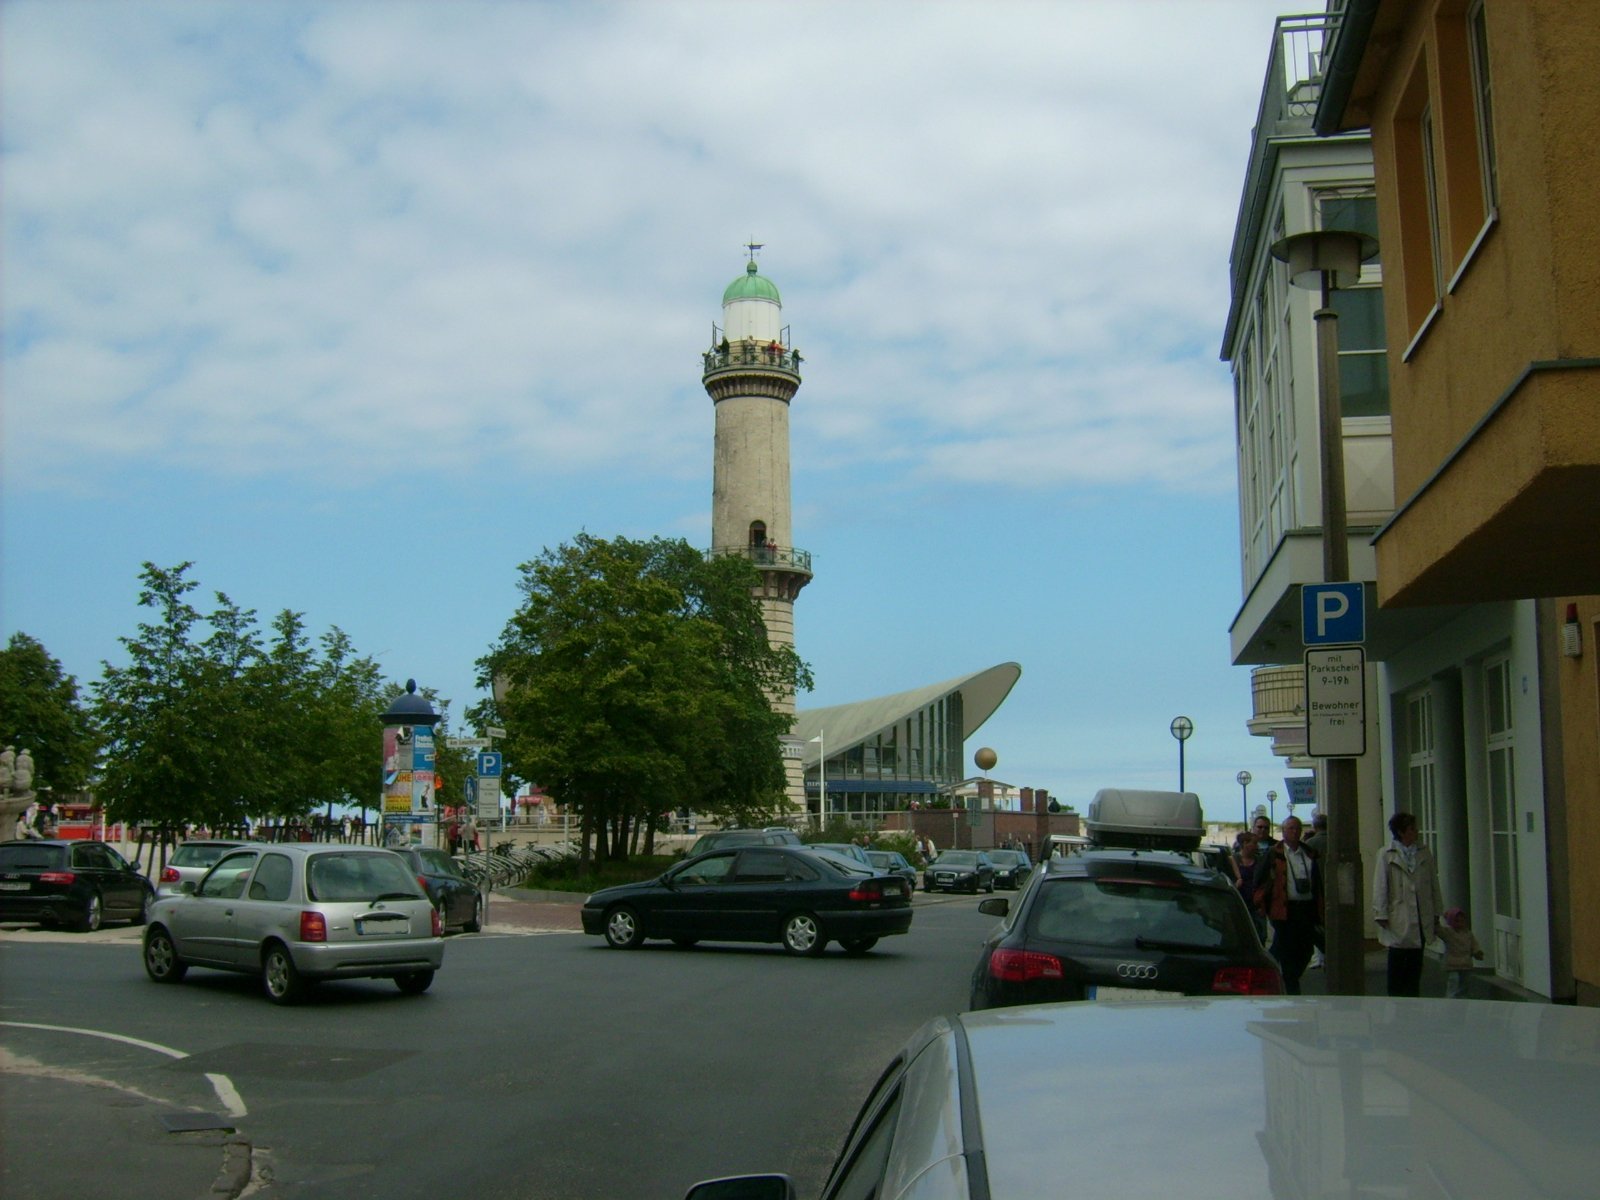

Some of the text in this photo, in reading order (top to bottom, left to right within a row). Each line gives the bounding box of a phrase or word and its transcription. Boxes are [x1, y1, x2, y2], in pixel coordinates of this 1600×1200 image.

[1317, 591, 1349, 636] P
[1312, 701, 1359, 710] Bewohner
[1330, 717, 1344, 726] frei
[483, 756, 496, 774] P
